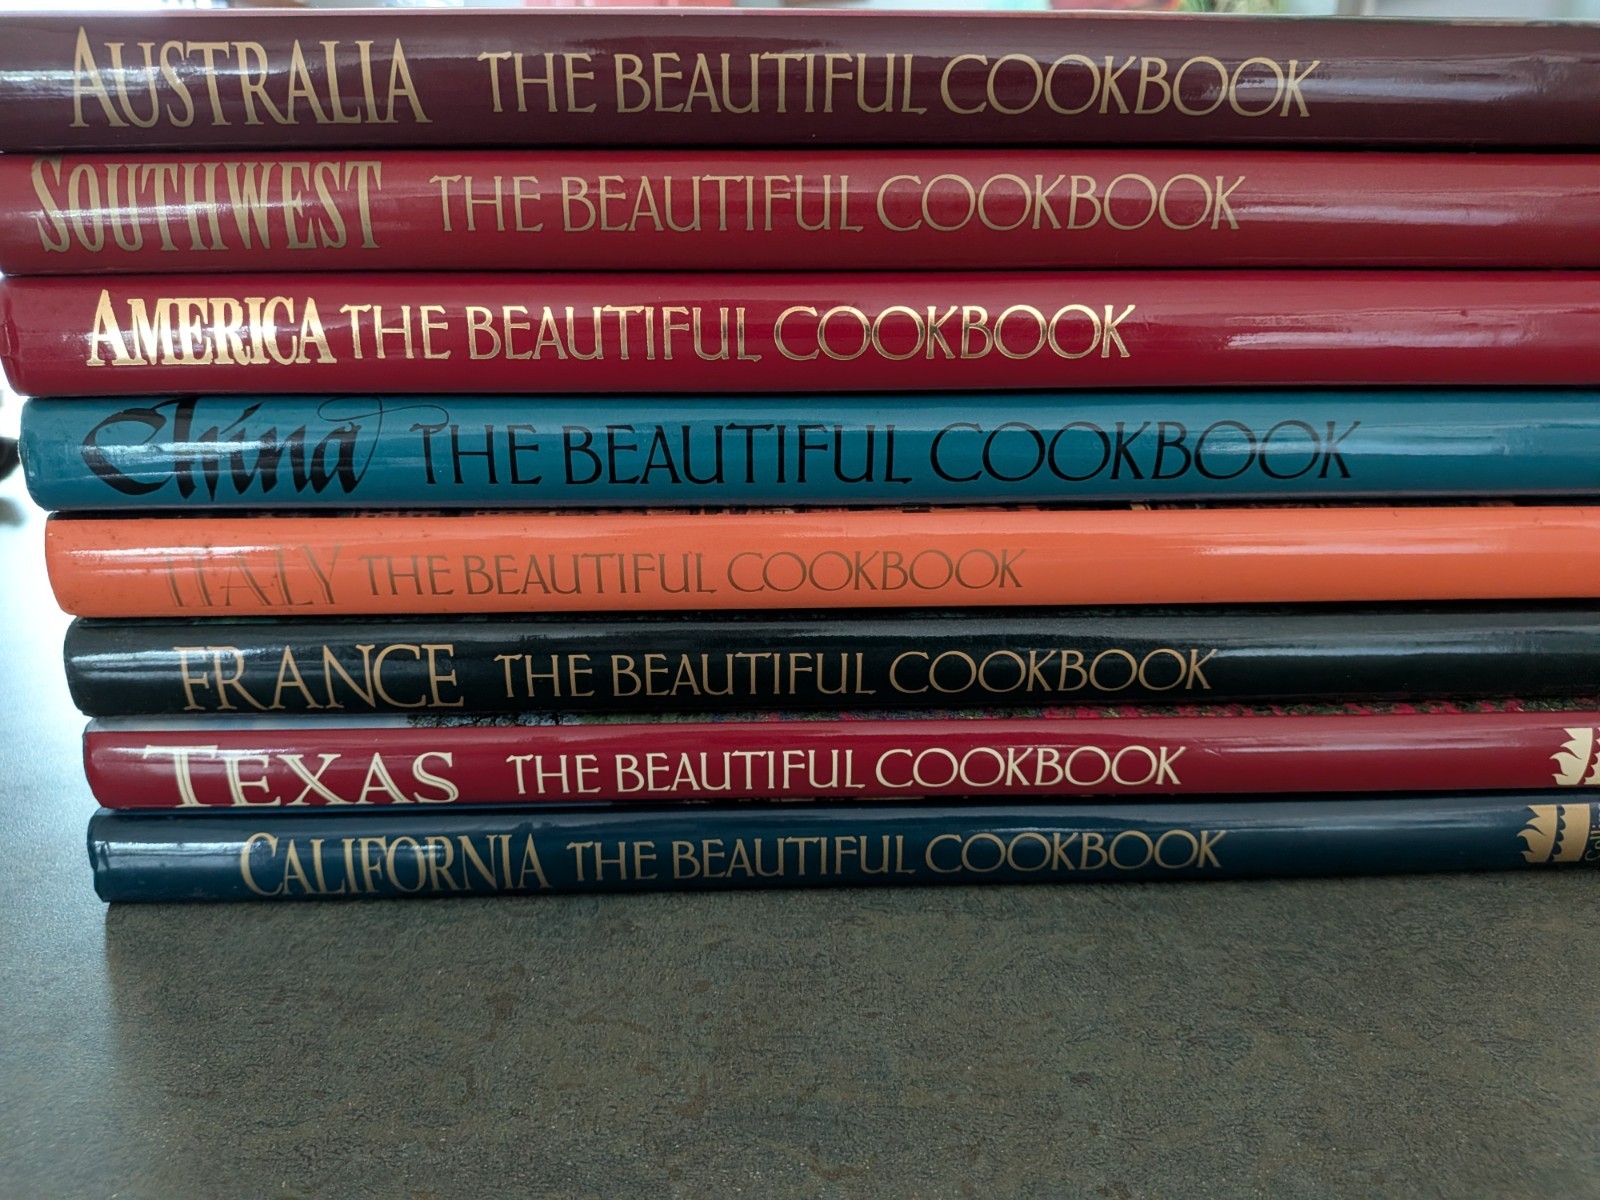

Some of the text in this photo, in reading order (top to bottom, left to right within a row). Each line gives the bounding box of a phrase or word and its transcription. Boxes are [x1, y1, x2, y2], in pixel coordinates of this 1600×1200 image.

[70, 26, 1321, 128] AUSTRALIA THE BEAUTIFUL COOKBOOK
[31, 156, 1246, 253] SOUTHWEST THE BEAUTIFUL COOKBOOK
[86, 289, 1136, 366] AMERICA THE BEAUTIFUL COOKBOOK
[82, 397, 1361, 502] China THE BEAUTIFUL COOKBOOK
[164, 544, 1027, 607] ITALY THE BEAUTIFUL COOKBOOK
[173, 643, 1218, 711] FRANCE THE BEAUTIFUL COOKBOOK
[143, 745, 1187, 809] TEXAS THE BEAUTIFUL COOKBOOK
[239, 829, 1227, 896] CALIFORNIA THE BEAUTIFUL COOKBOOK
